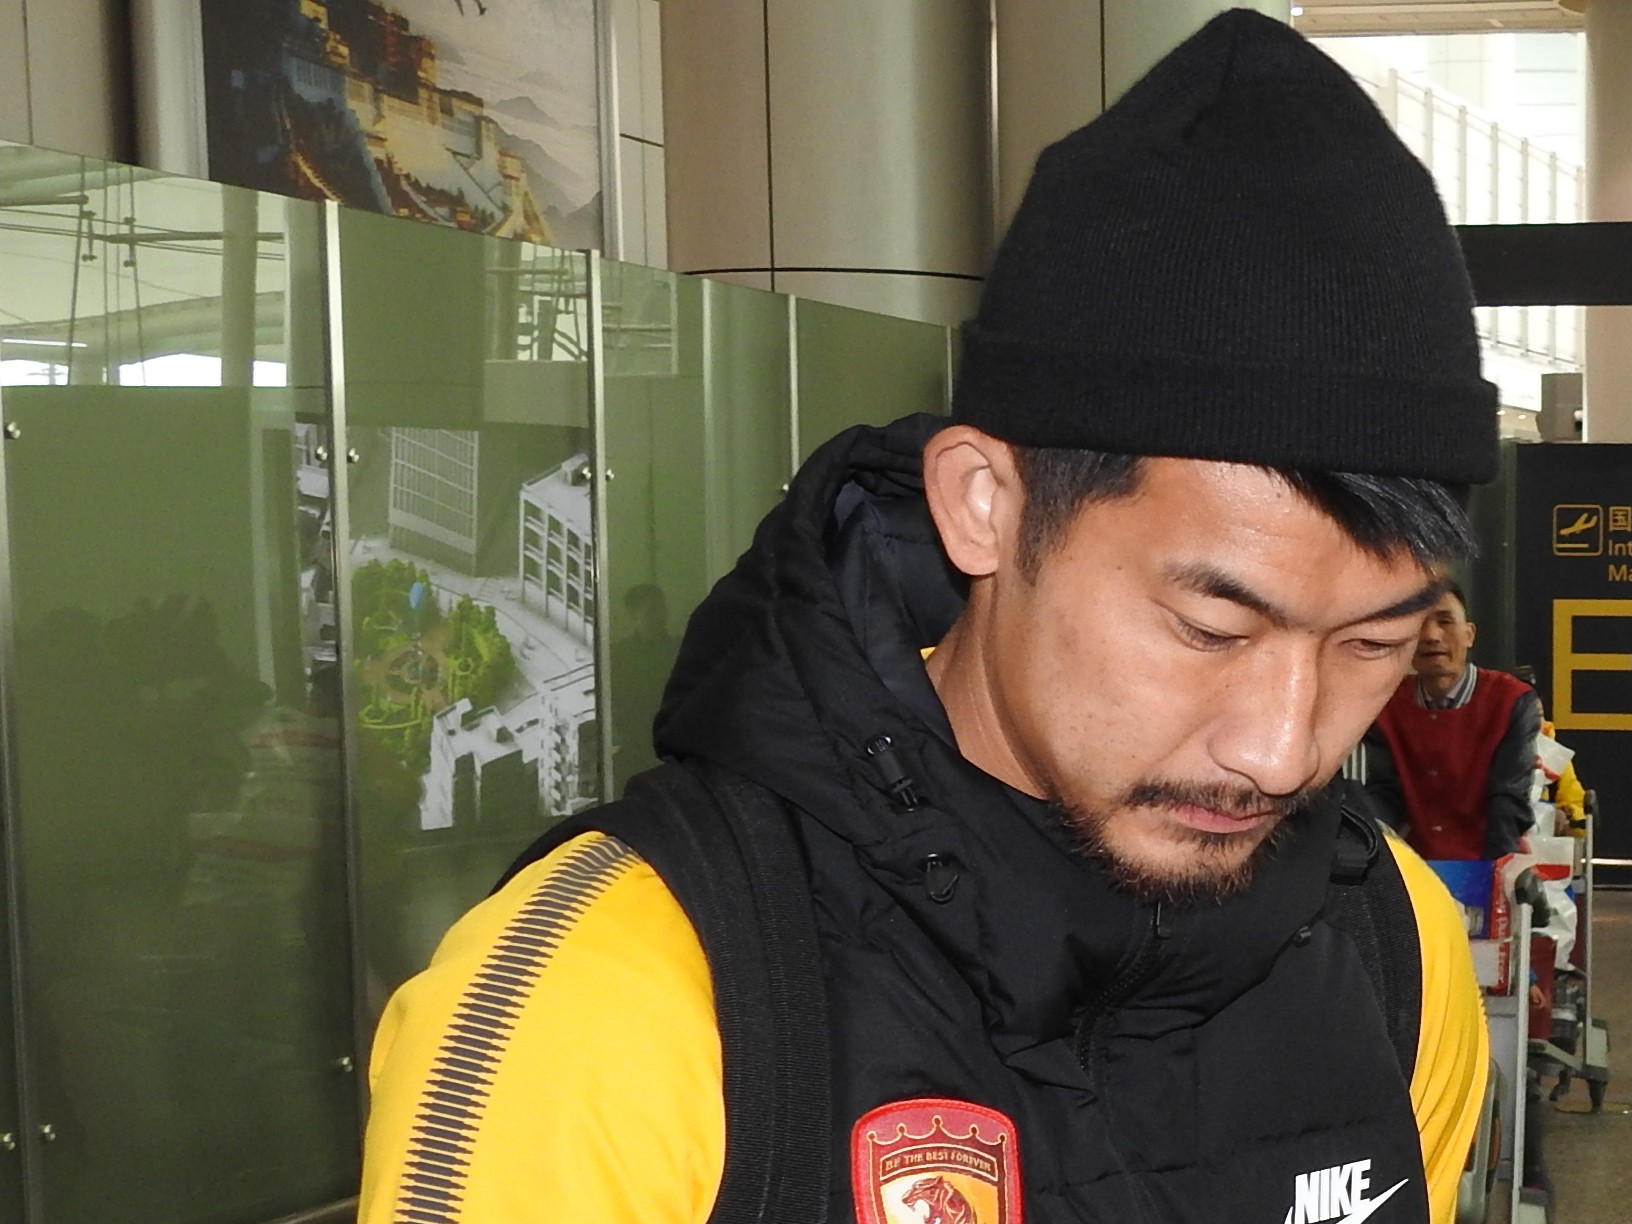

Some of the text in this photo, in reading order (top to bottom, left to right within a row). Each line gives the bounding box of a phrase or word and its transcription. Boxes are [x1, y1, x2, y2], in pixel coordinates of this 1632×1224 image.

[903, 1154, 924, 1165] THE
[925, 1151, 948, 1161] BEST
[950, 1151, 991, 1172] FOREVER
